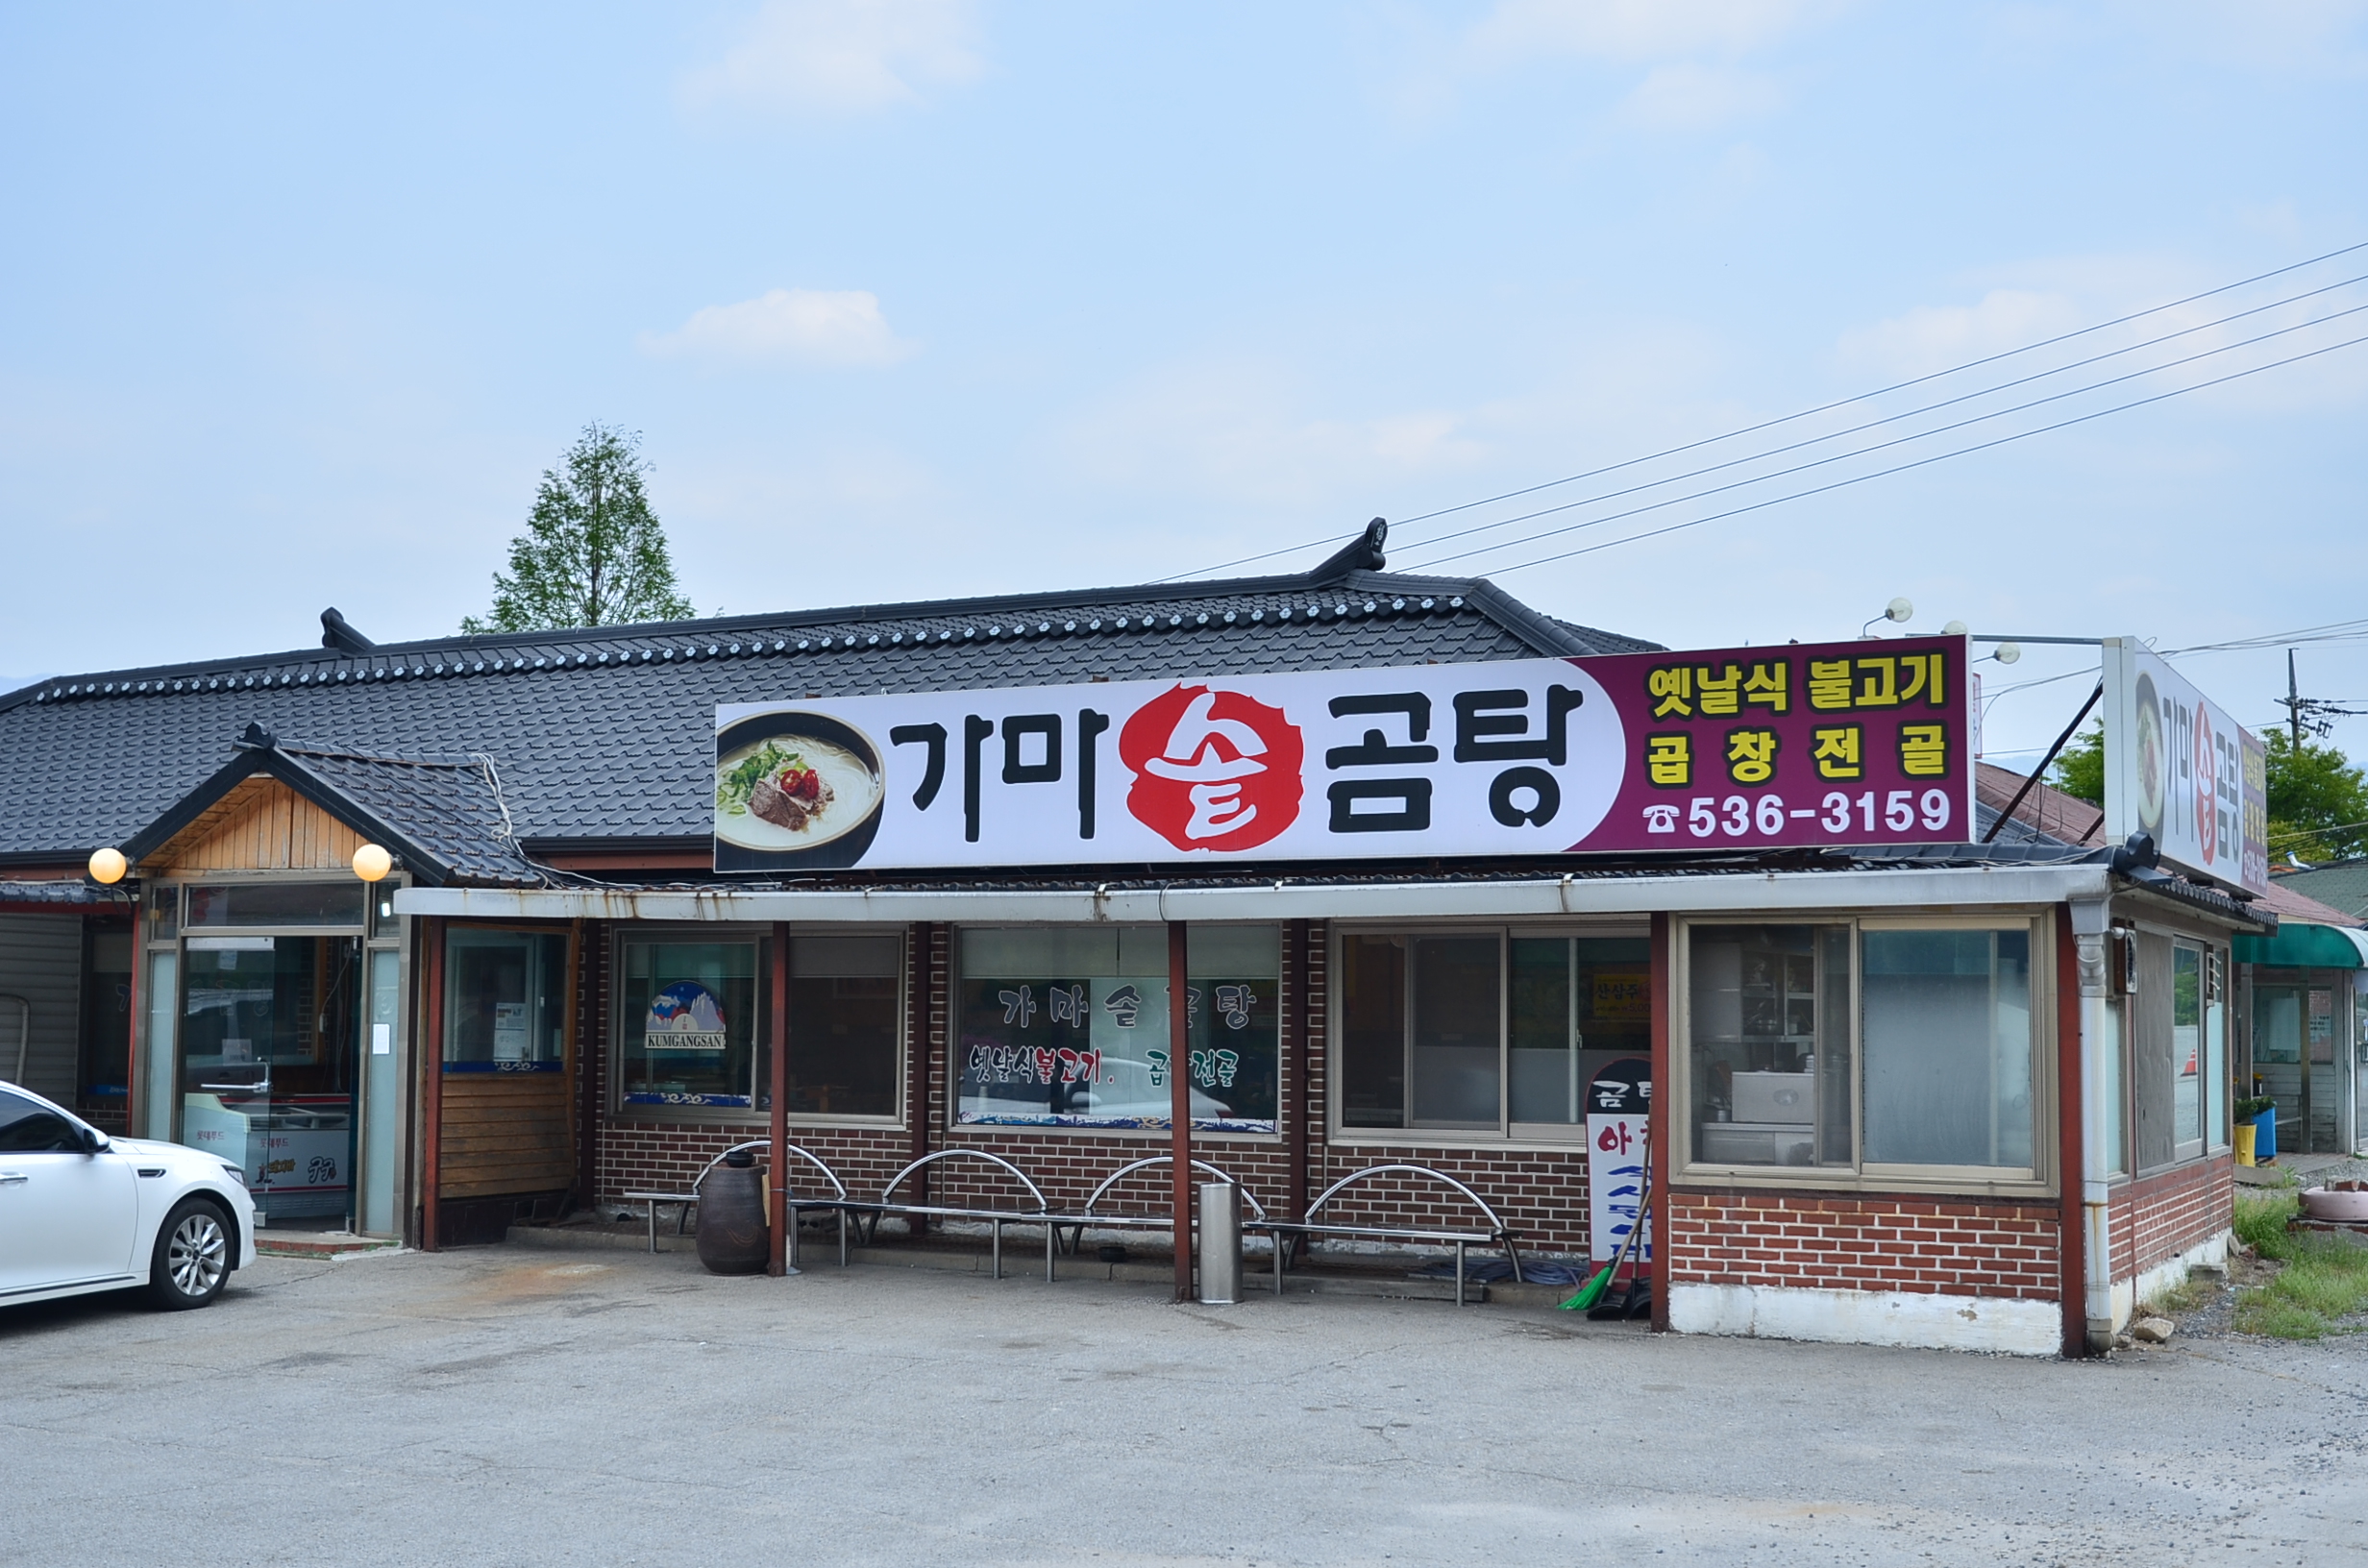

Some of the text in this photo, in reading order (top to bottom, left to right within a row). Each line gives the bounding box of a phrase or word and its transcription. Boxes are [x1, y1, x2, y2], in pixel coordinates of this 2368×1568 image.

[1648, 663, 1788, 720] 옛날식
[1810, 653, 1944, 709] 불고기
[1689, 788, 1950, 838] 536-3159
[1595, 983, 1638, 1000] 산삼주
[648, 1035, 722, 1047] KUMGANGSAN
[1146, 1048, 1239, 1088] 곱전골
